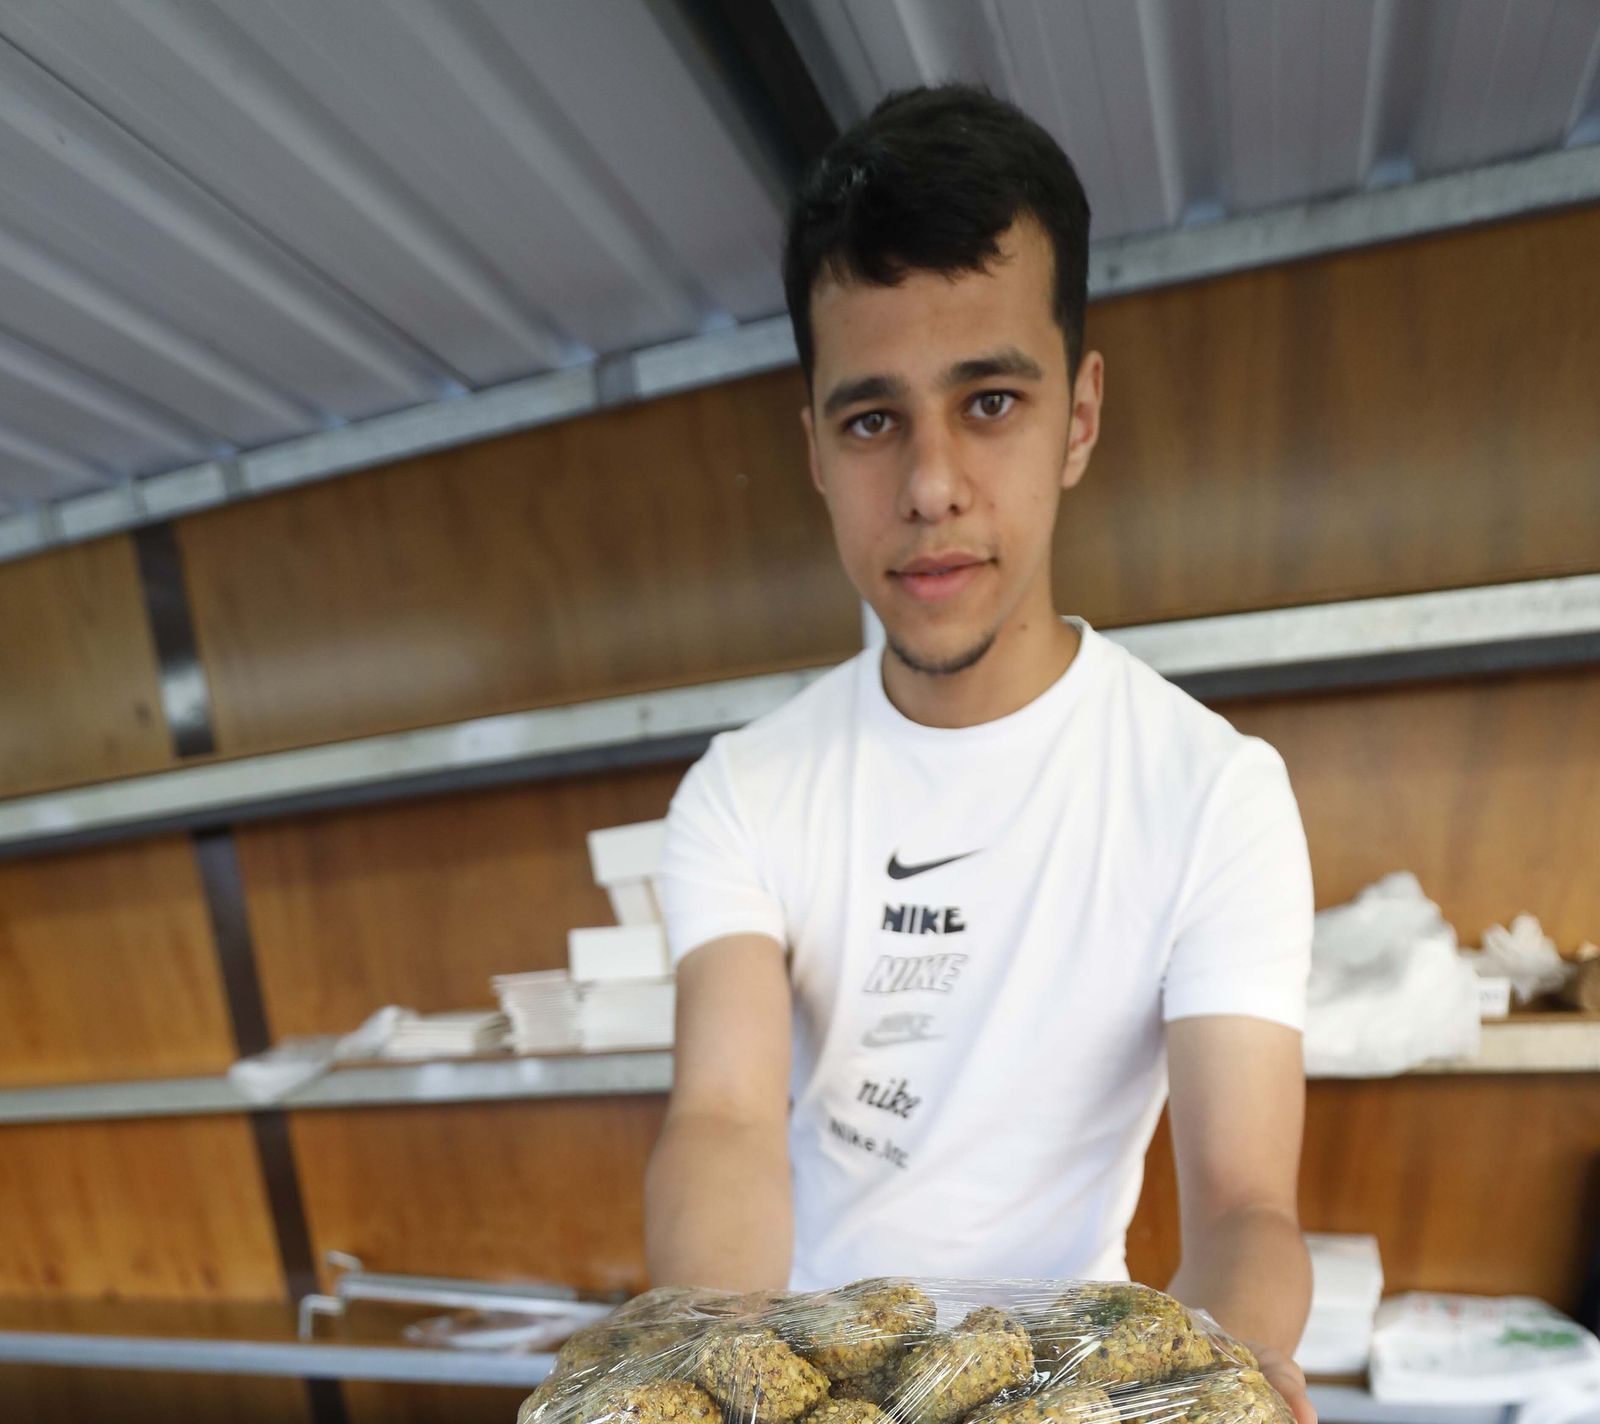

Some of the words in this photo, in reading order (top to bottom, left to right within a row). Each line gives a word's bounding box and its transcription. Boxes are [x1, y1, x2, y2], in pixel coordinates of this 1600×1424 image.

[881, 904, 967, 935] NIKE
[863, 953, 969, 993] NIKE
[856, 1079, 921, 1119] nike
